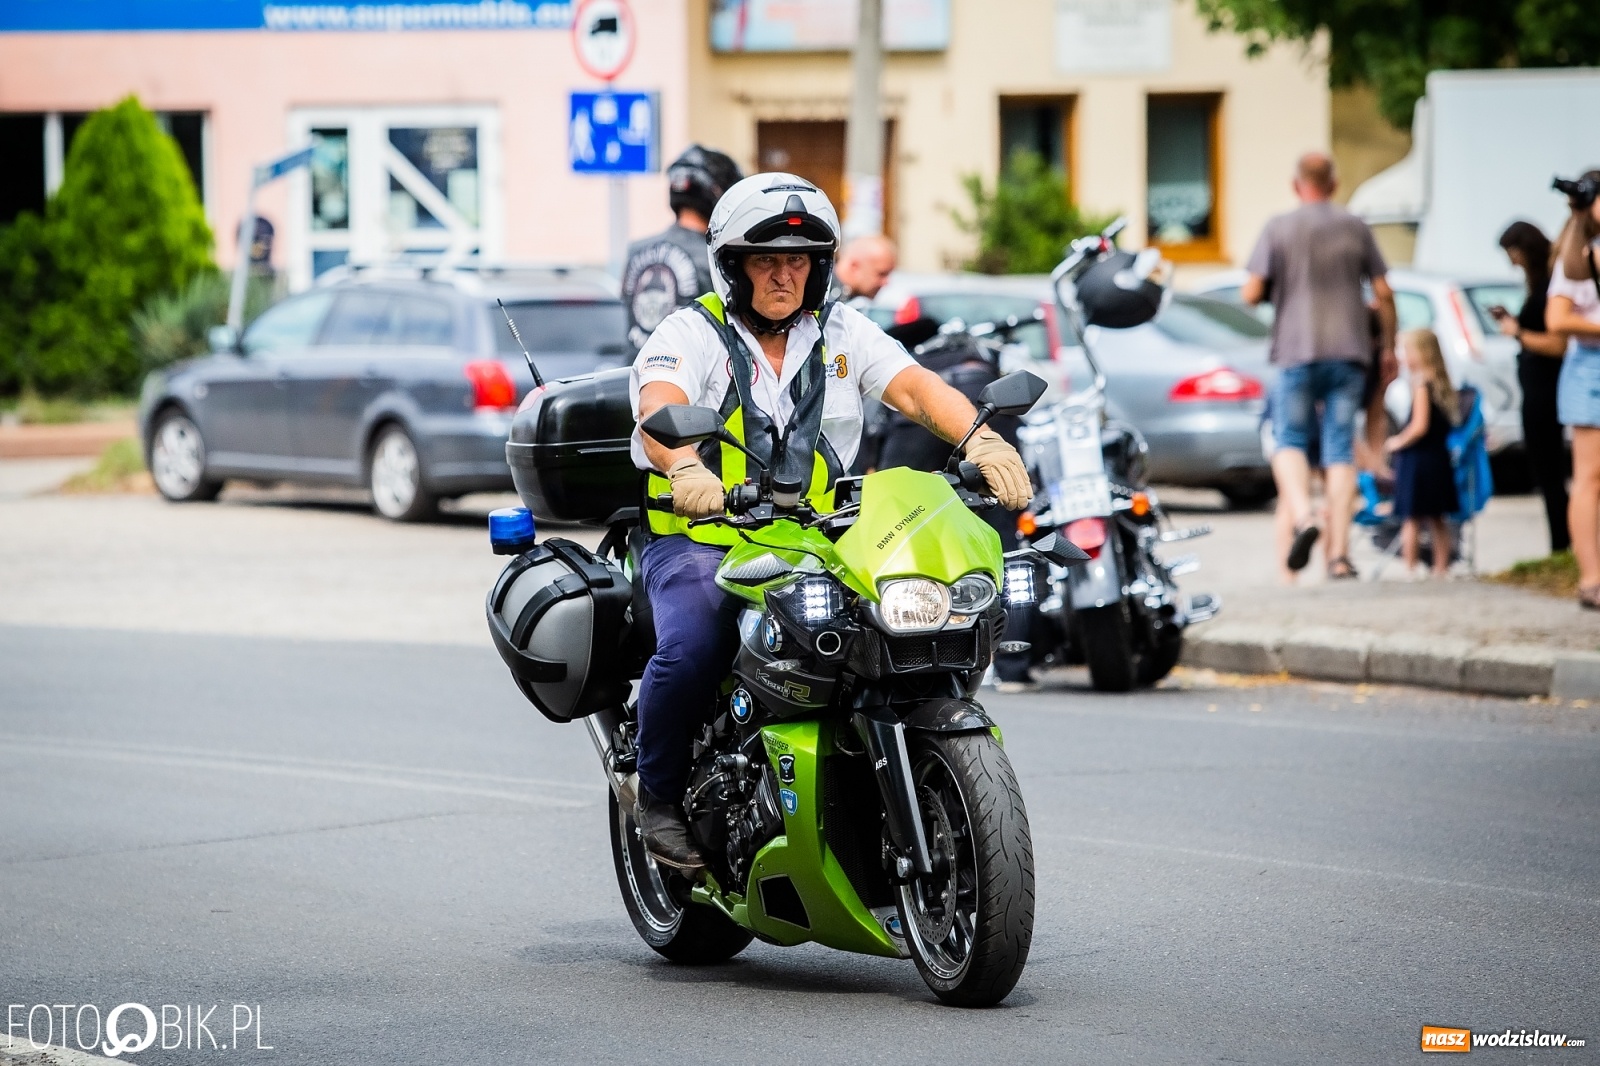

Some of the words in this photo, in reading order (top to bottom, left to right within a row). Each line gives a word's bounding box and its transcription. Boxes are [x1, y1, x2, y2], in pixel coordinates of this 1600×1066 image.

[876, 530, 895, 550] BMW
[894, 505, 926, 531] DYNAMIC
[875, 756, 888, 771] ABS
